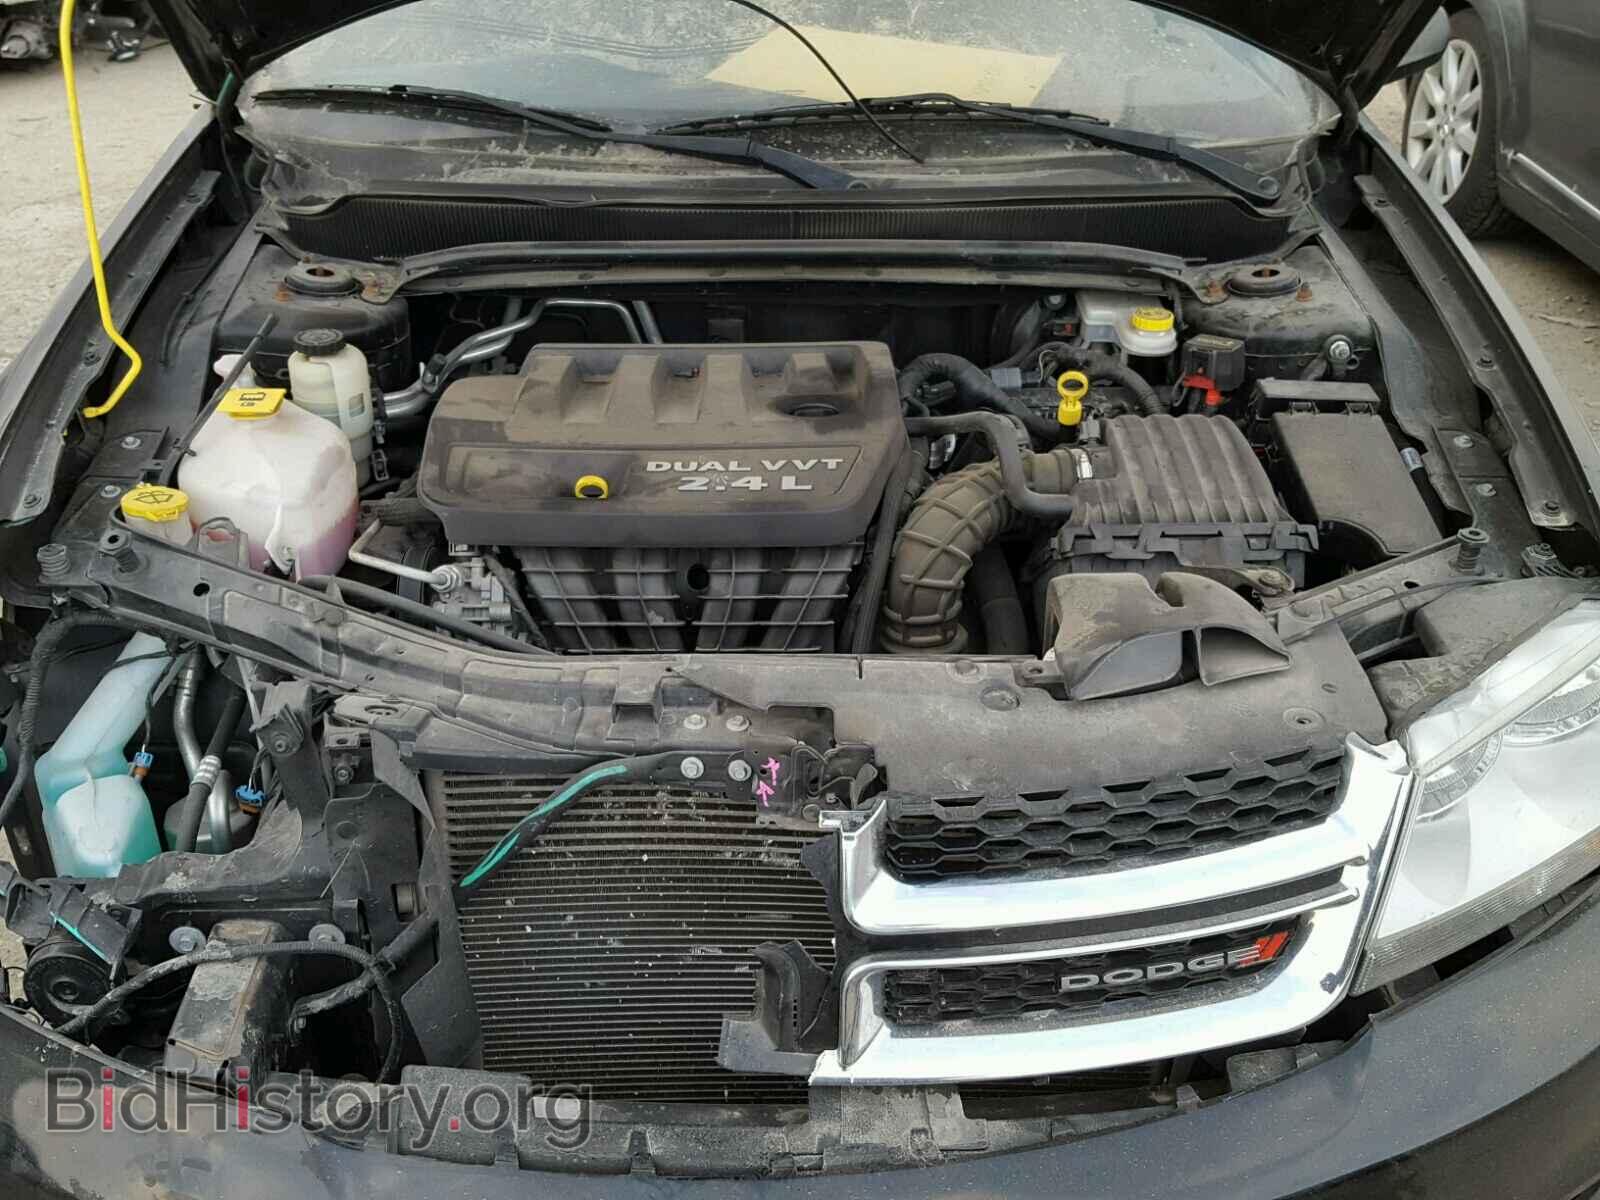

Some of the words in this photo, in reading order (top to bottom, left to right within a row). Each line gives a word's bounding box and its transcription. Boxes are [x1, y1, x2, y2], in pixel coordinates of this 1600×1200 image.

[646, 461, 751, 472] DUAL
[761, 458, 844, 470] VVT
[1060, 945, 1261, 992] DODGE
